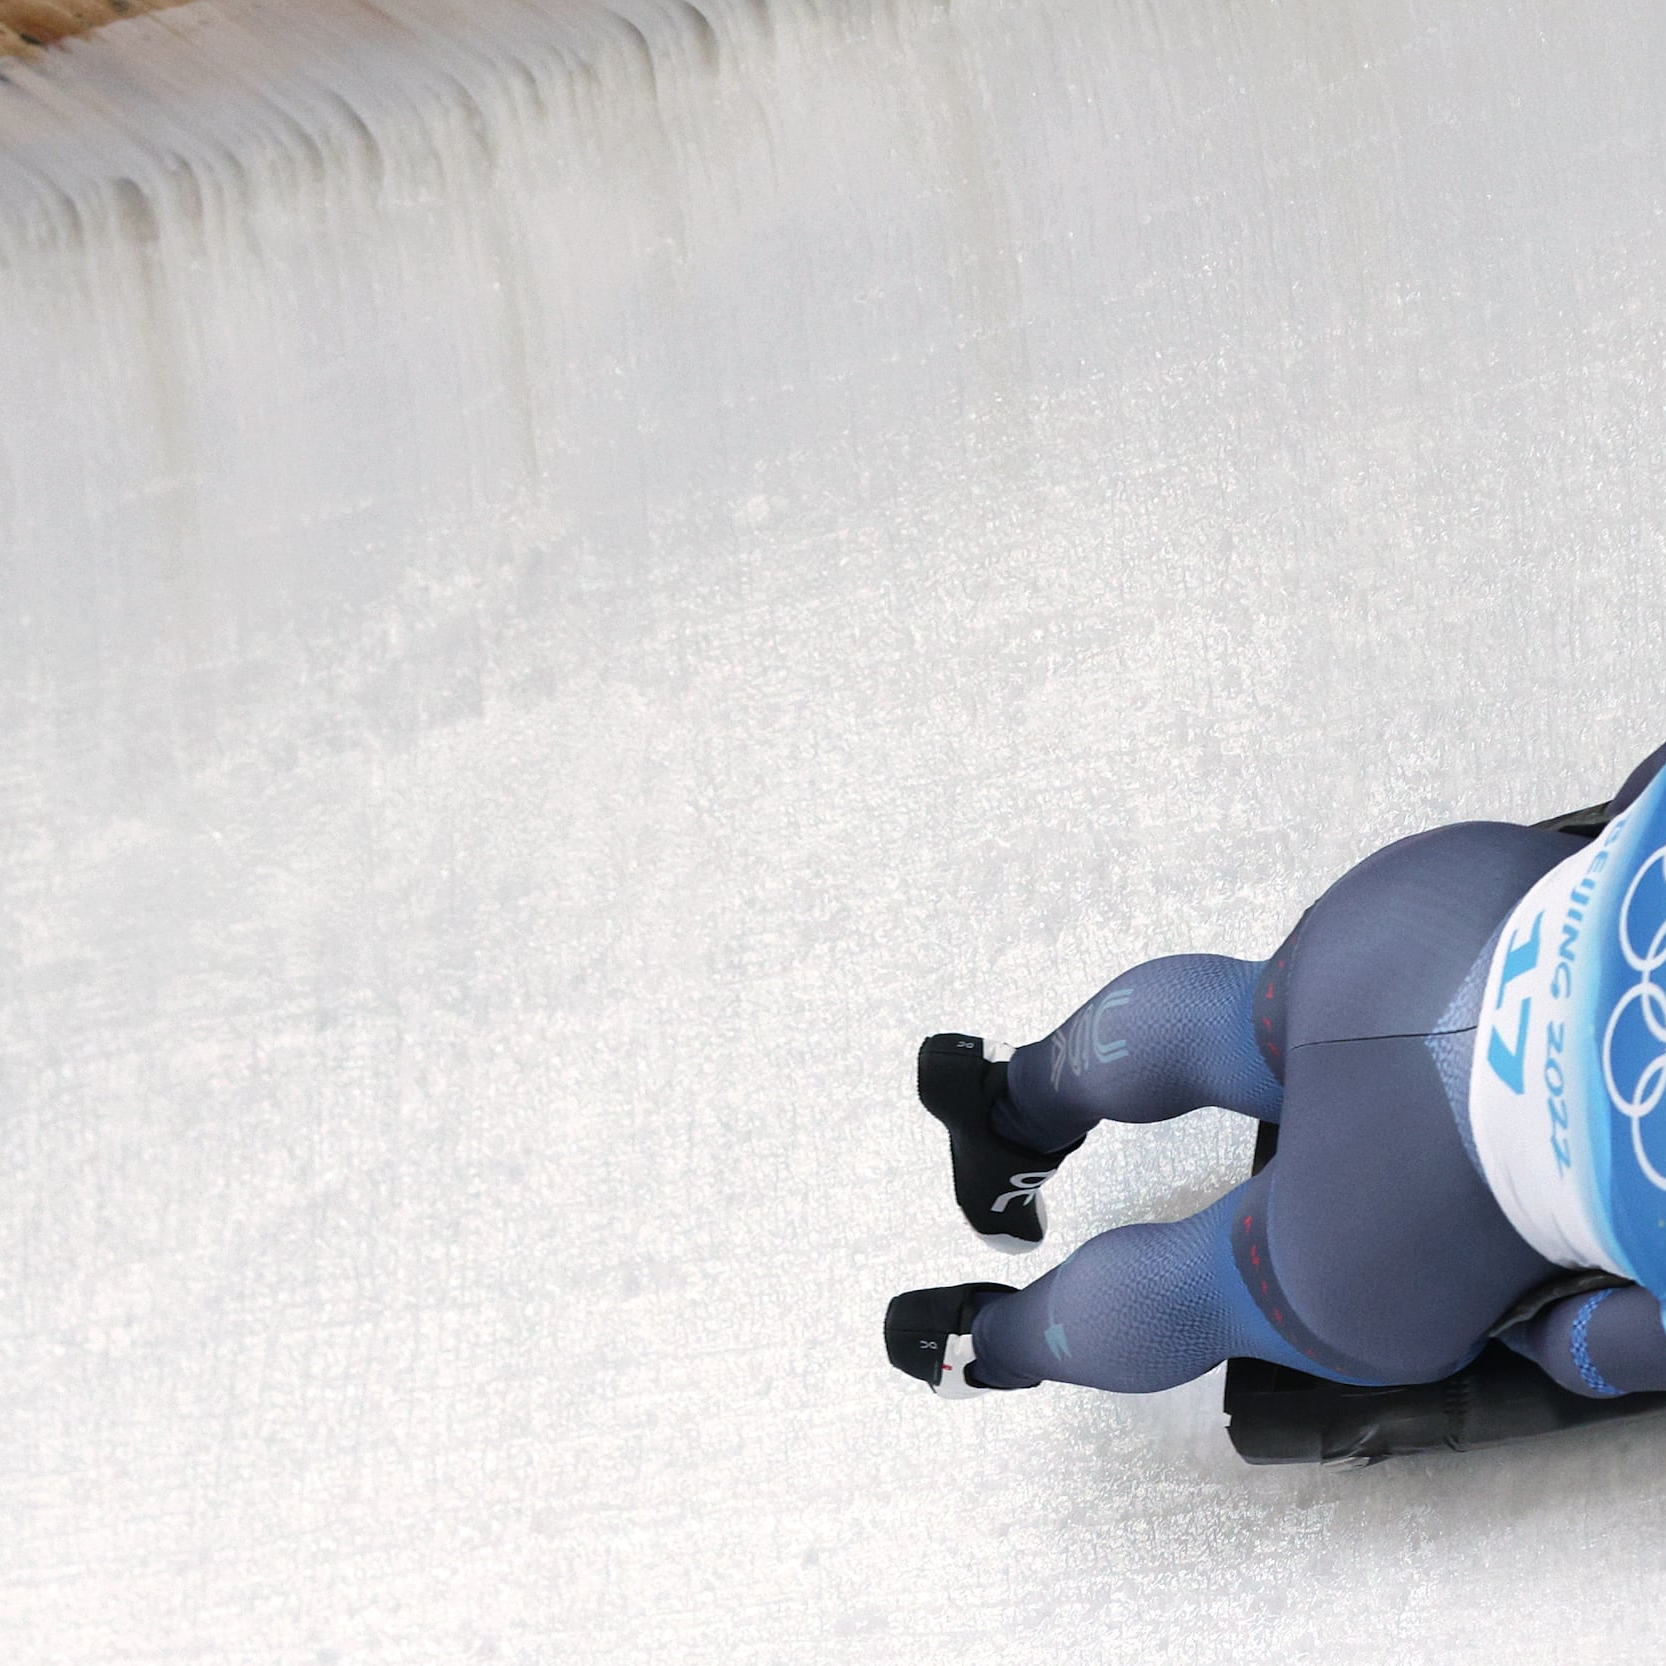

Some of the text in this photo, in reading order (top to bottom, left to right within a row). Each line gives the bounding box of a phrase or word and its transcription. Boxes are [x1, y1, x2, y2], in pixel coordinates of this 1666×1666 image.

[1487, 909, 1546, 1096] 17
[1543, 818, 1628, 1180] BEIJING 2022
